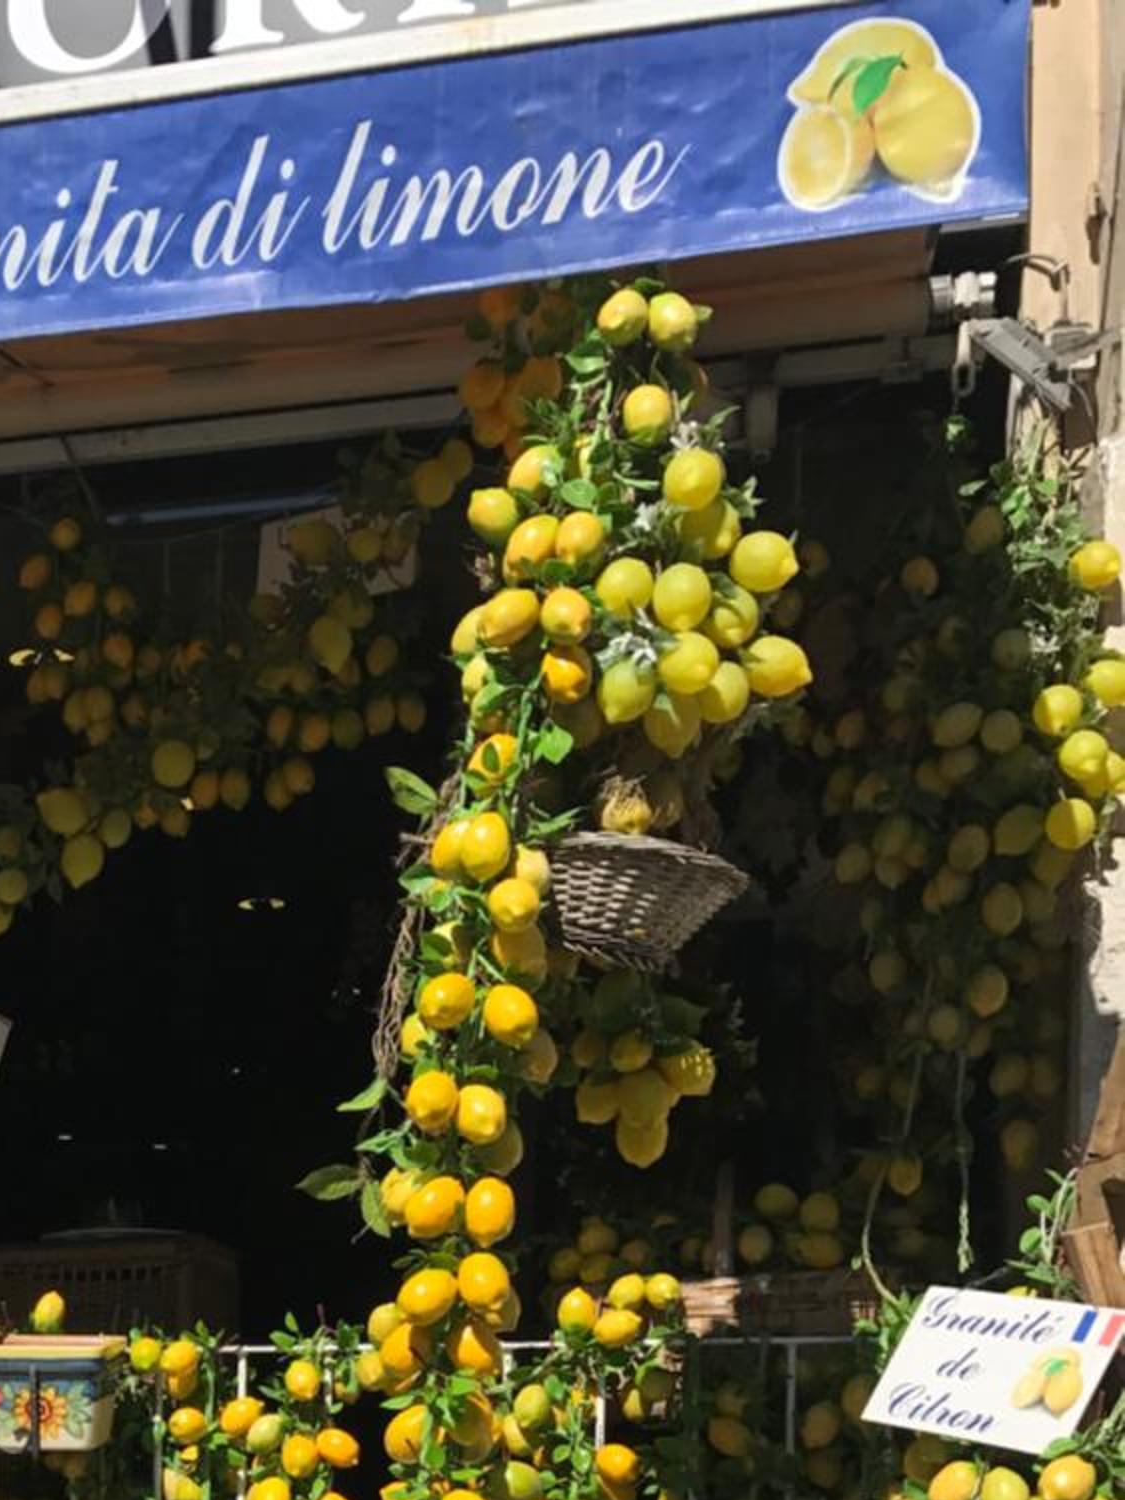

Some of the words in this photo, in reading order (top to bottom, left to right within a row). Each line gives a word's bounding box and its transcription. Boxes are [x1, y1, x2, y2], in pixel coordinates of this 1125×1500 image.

[191, 135, 309, 271] di
[320, 121, 692, 258] limone
[921, 1294, 1064, 1343] Granité
[935, 1346, 982, 1380] de
[887, 1381, 996, 1433] Citron
